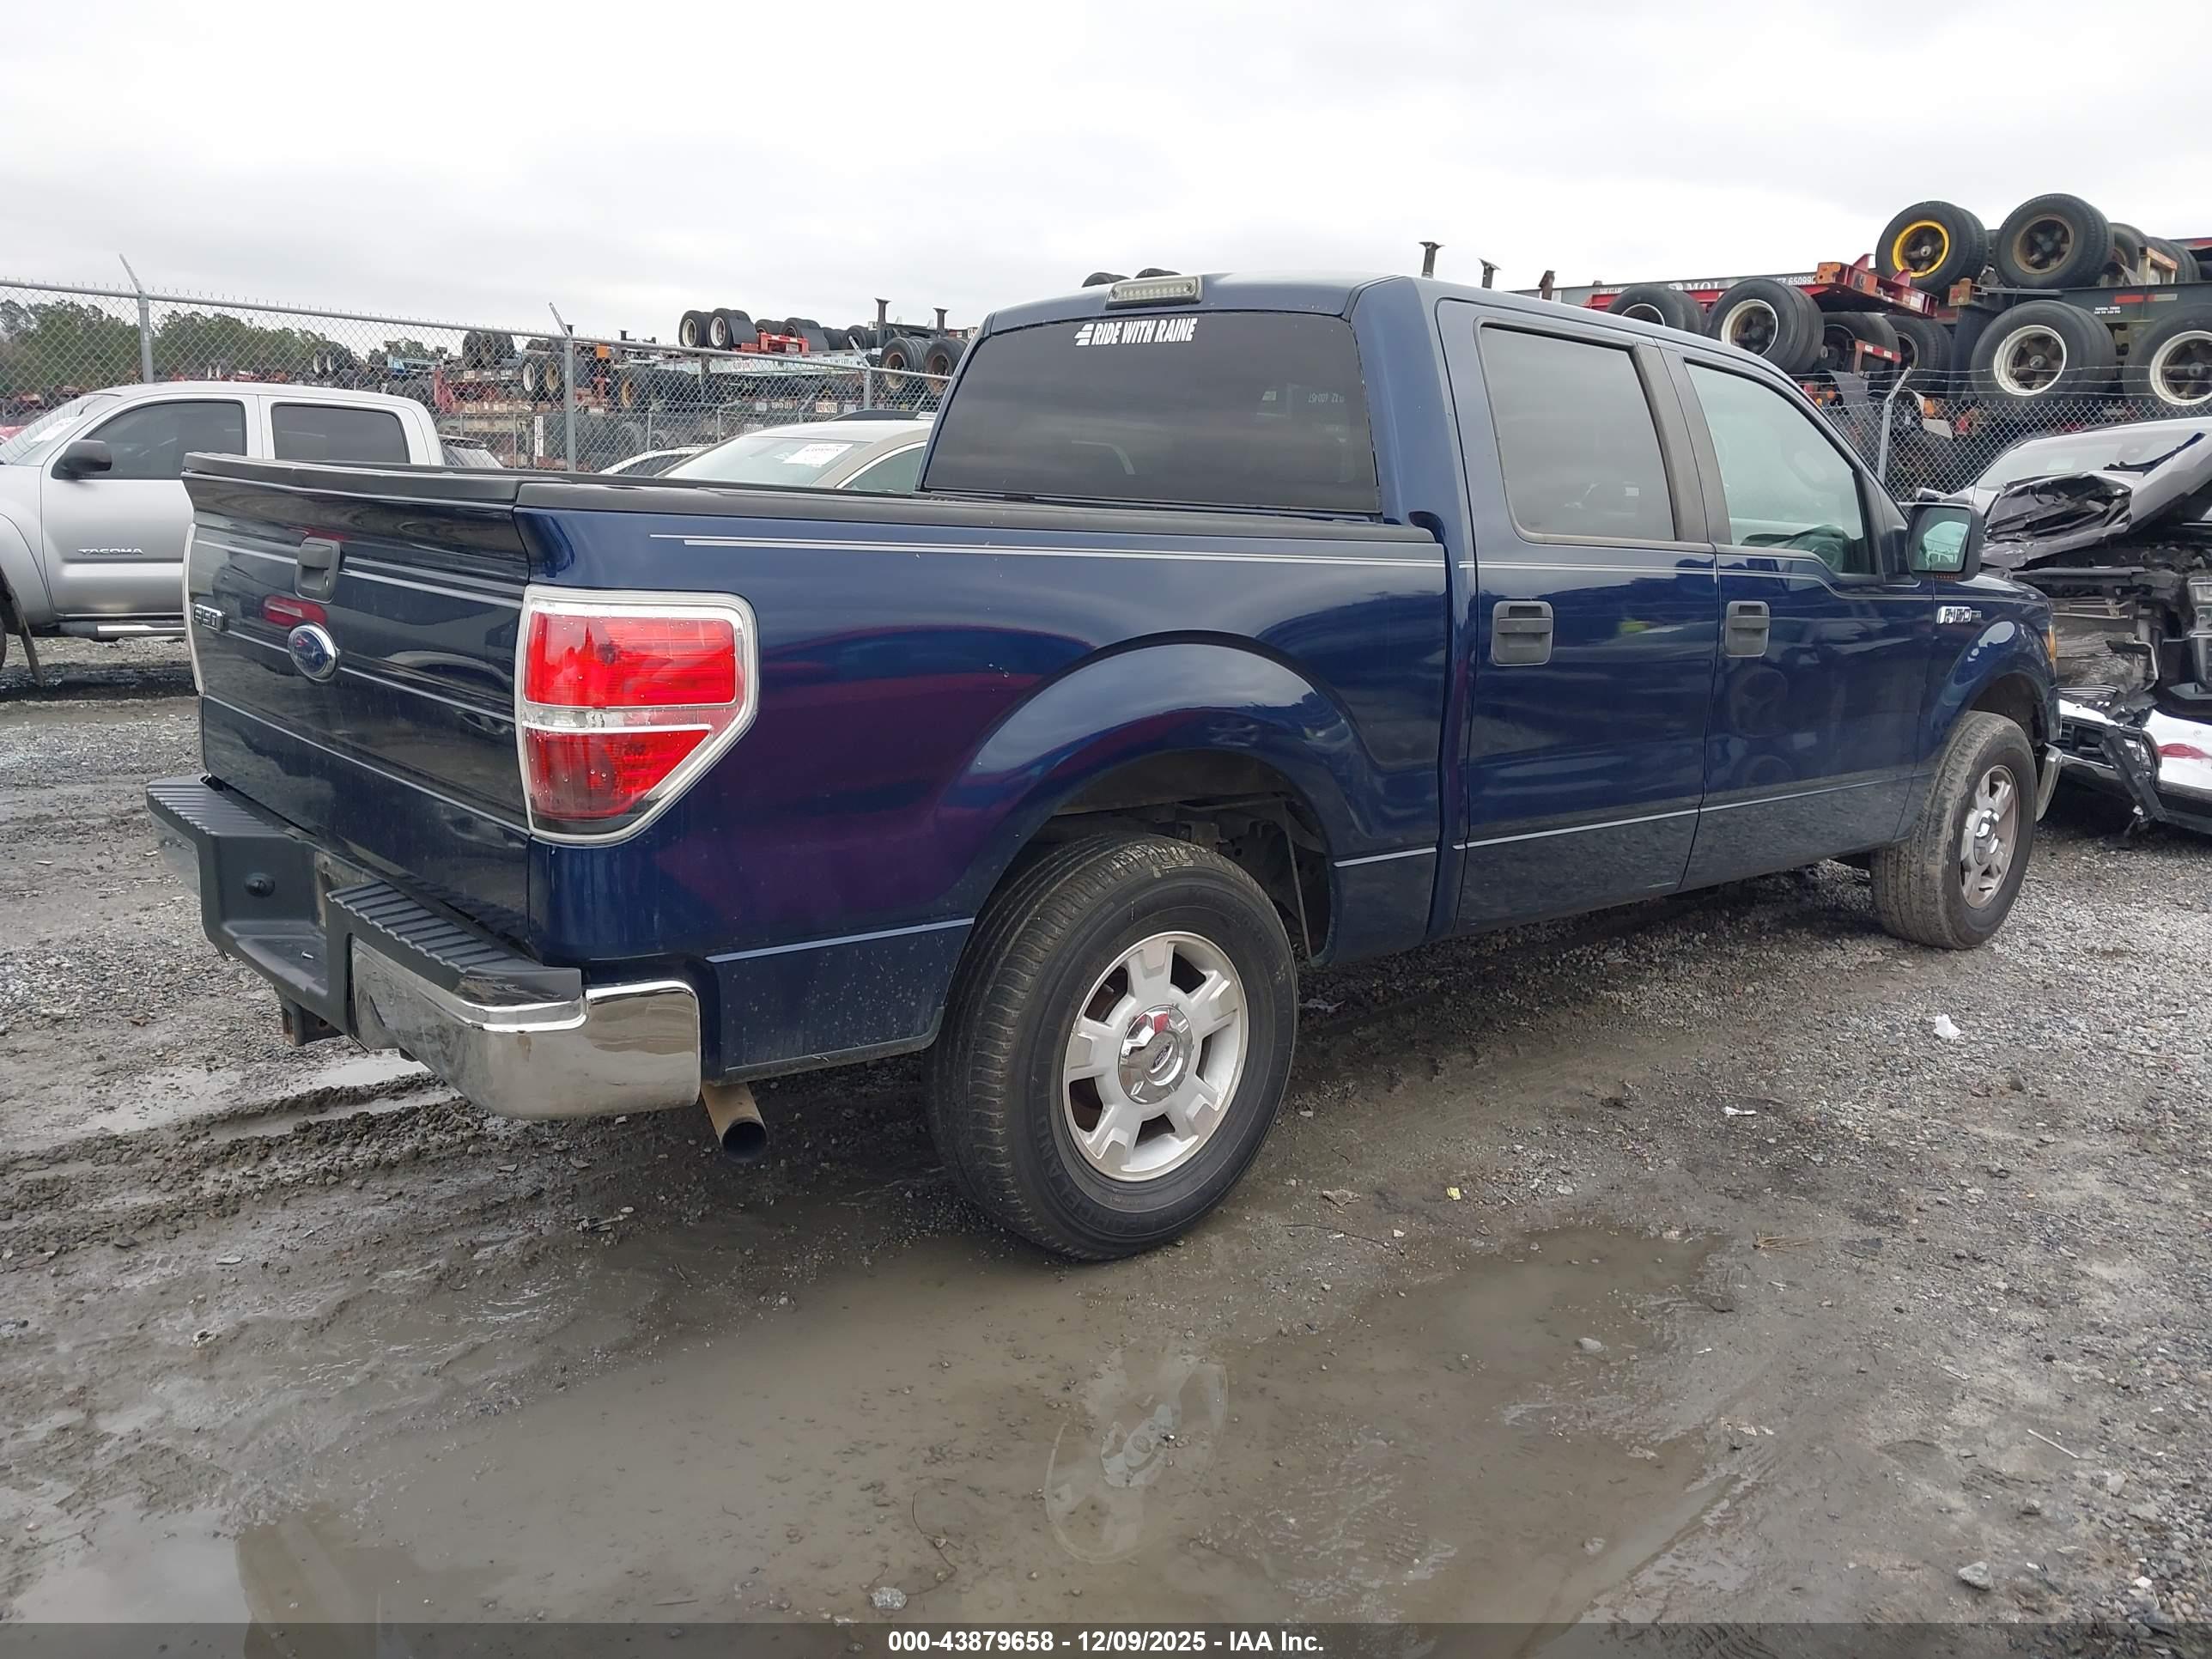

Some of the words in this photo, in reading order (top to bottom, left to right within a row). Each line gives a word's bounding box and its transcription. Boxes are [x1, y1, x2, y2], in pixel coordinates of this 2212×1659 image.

[1091, 322, 1122, 345] RIDE
[1121, 319, 1157, 343] WITH
[1154, 318, 1198, 342] RAINE
